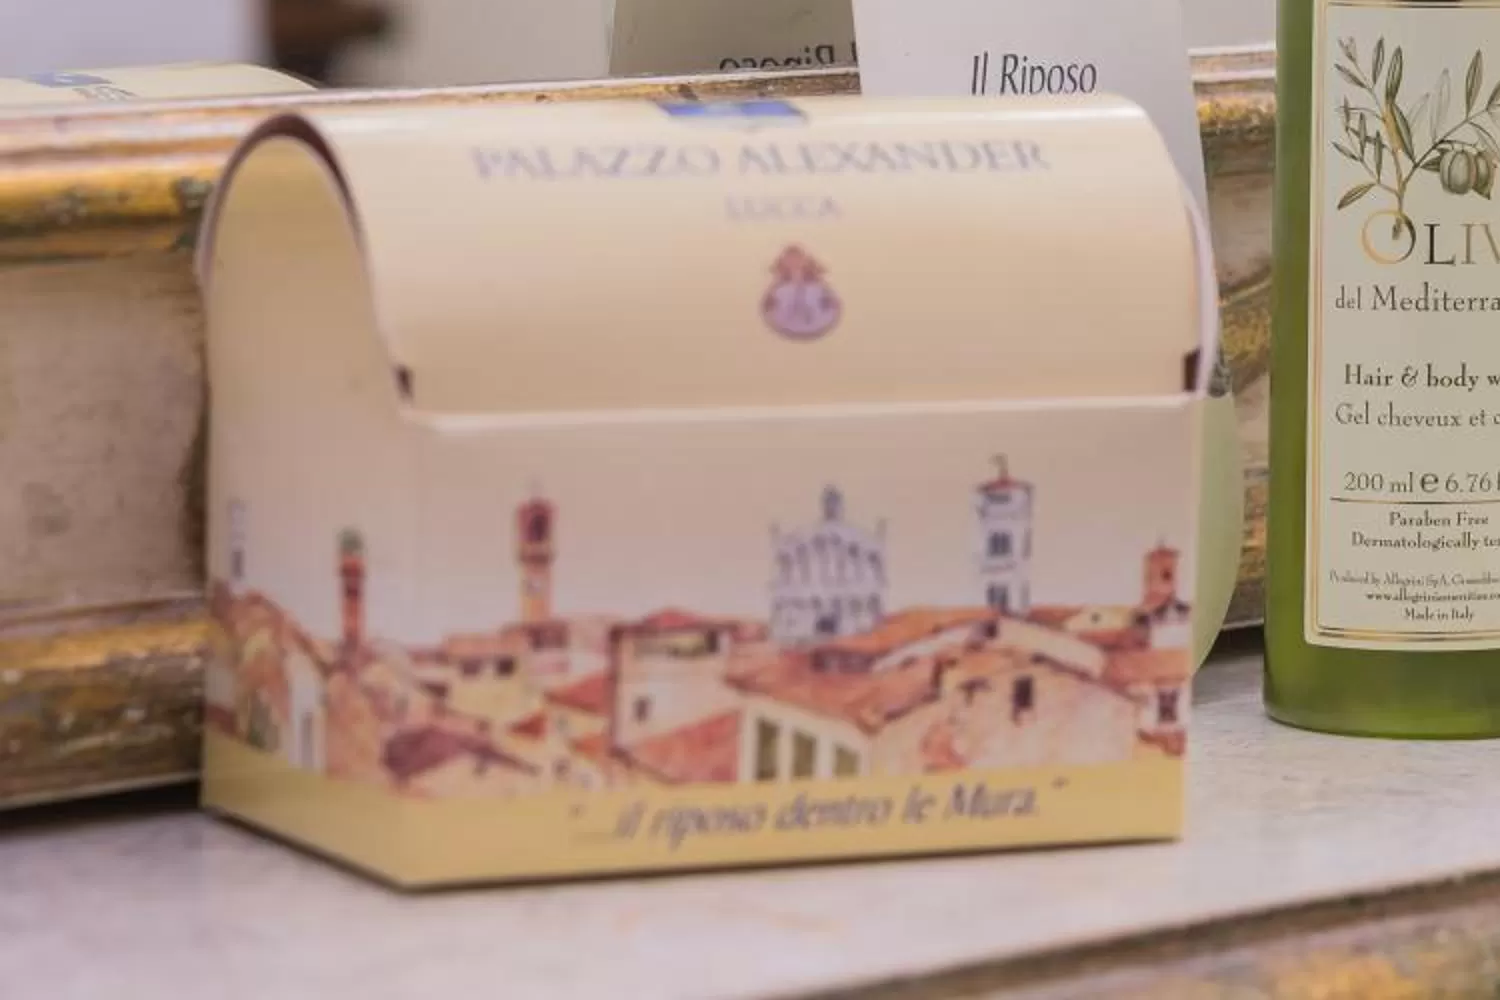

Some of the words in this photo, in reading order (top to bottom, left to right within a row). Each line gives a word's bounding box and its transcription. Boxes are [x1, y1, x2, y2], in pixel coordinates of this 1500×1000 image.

[971, 51, 989, 95] Il
[999, 53, 1098, 96] Riposo
[470, 142, 719, 180] PALAZZO
[736, 139, 1050, 178] ALEXANDER
[727, 193, 841, 223] LUCCA
[1336, 285, 1361, 310] del
[1345, 364, 1393, 386] Hair
[1401, 366, 1418, 387] &
[1427, 363, 1479, 392] body
[1335, 400, 1369, 424] Gel
[1378, 401, 1461, 427] cheveux
[1469, 410, 1486, 427] et
[1344, 472, 1384, 491] 200
[1390, 472, 1413, 493] ml
[1445, 472, 1491, 493] 6.76
[1390, 509, 1450, 526] Paraben
[1456, 510, 1488, 526] Free
[1352, 532, 1480, 552] Dermatologically
[1404, 607, 1435, 621] Made
[1438, 607, 1448, 619] in
[1451, 605, 1474, 622] Italy
